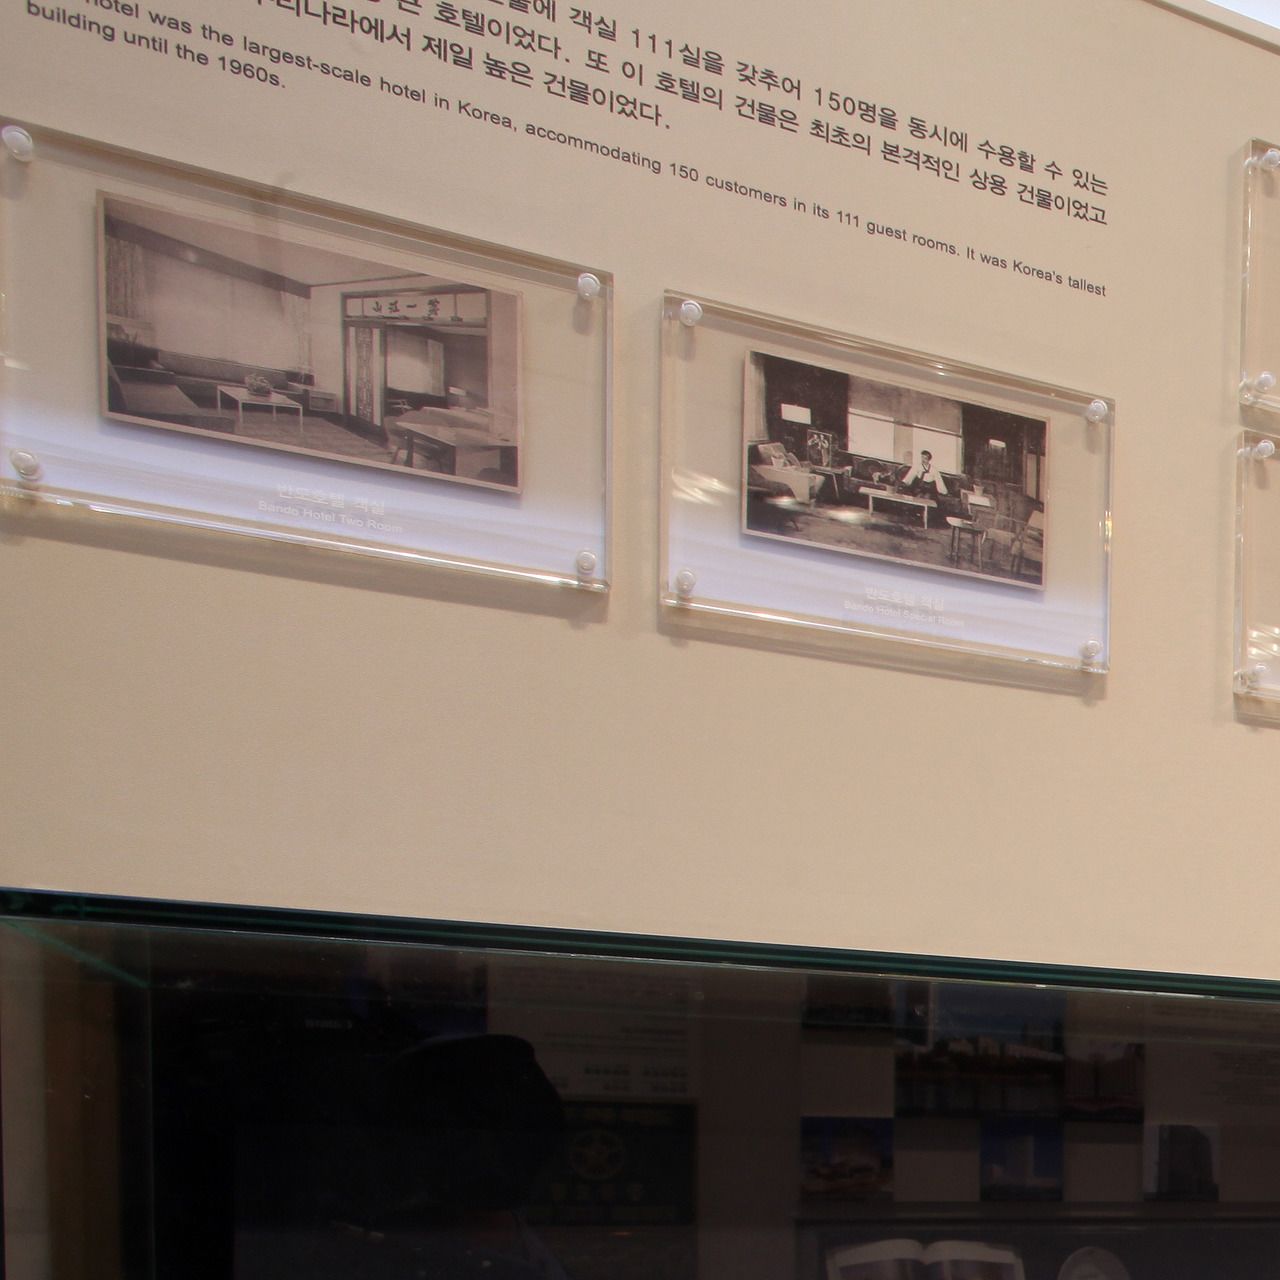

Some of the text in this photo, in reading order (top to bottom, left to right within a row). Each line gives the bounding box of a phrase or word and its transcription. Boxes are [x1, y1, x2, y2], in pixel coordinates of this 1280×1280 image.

[27, 0, 285, 88] building until the 1960s.
[422, 35, 473, 70] 제일
[483, 52, 534, 88] 높은
[543, 72, 670, 129] 건물이었다.
[434, 1, 570, 63] 호텔이었다.
[585, 49, 610, 73] 또
[622, 62, 643, 86] 이
[655, 72, 722, 111] 호텔의
[735, 96, 799, 133] 건물은
[809, 119, 870, 156] 최초의
[881, 140, 959, 182] 본격적인
[969, 169, 1008, 196] 상용
[1017, 183, 1107, 225] 건물이었고
[569, 7, 616, 42] 객실
[632, 29, 725, 75] 111실을
[736, 61, 800, 100] 갖추어
[815, 88, 898, 127] 150명을
[908, 116, 967, 153] 동시에
[977, 139, 1036, 174] 수용할
[1045, 161, 1064, 181] 수
[1072, 169, 1108, 196] 있는
[148, 11, 192, 34] was
[201, 24, 233, 46] the
[244, 36, 371, 87] largest-scale
[380, 77, 425, 103] hotel
[435, 93, 449, 110] in
[459, 100, 517, 132] Korea,
[525, 124, 661, 174] accommodating
[670, 163, 698, 181] 150
[706, 176, 787, 207] customers
[794, 198, 806, 213] in
[813, 203, 829, 219] its
[837, 211, 858, 227] 111
[867, 222, 907, 241] guest
[913, 234, 959, 256] rooms.
[967, 247, 975, 260] It
[981, 253, 1007, 269] was
[1013, 260, 1062, 284] Korea's
[1069, 276, 1105, 297] tallest
